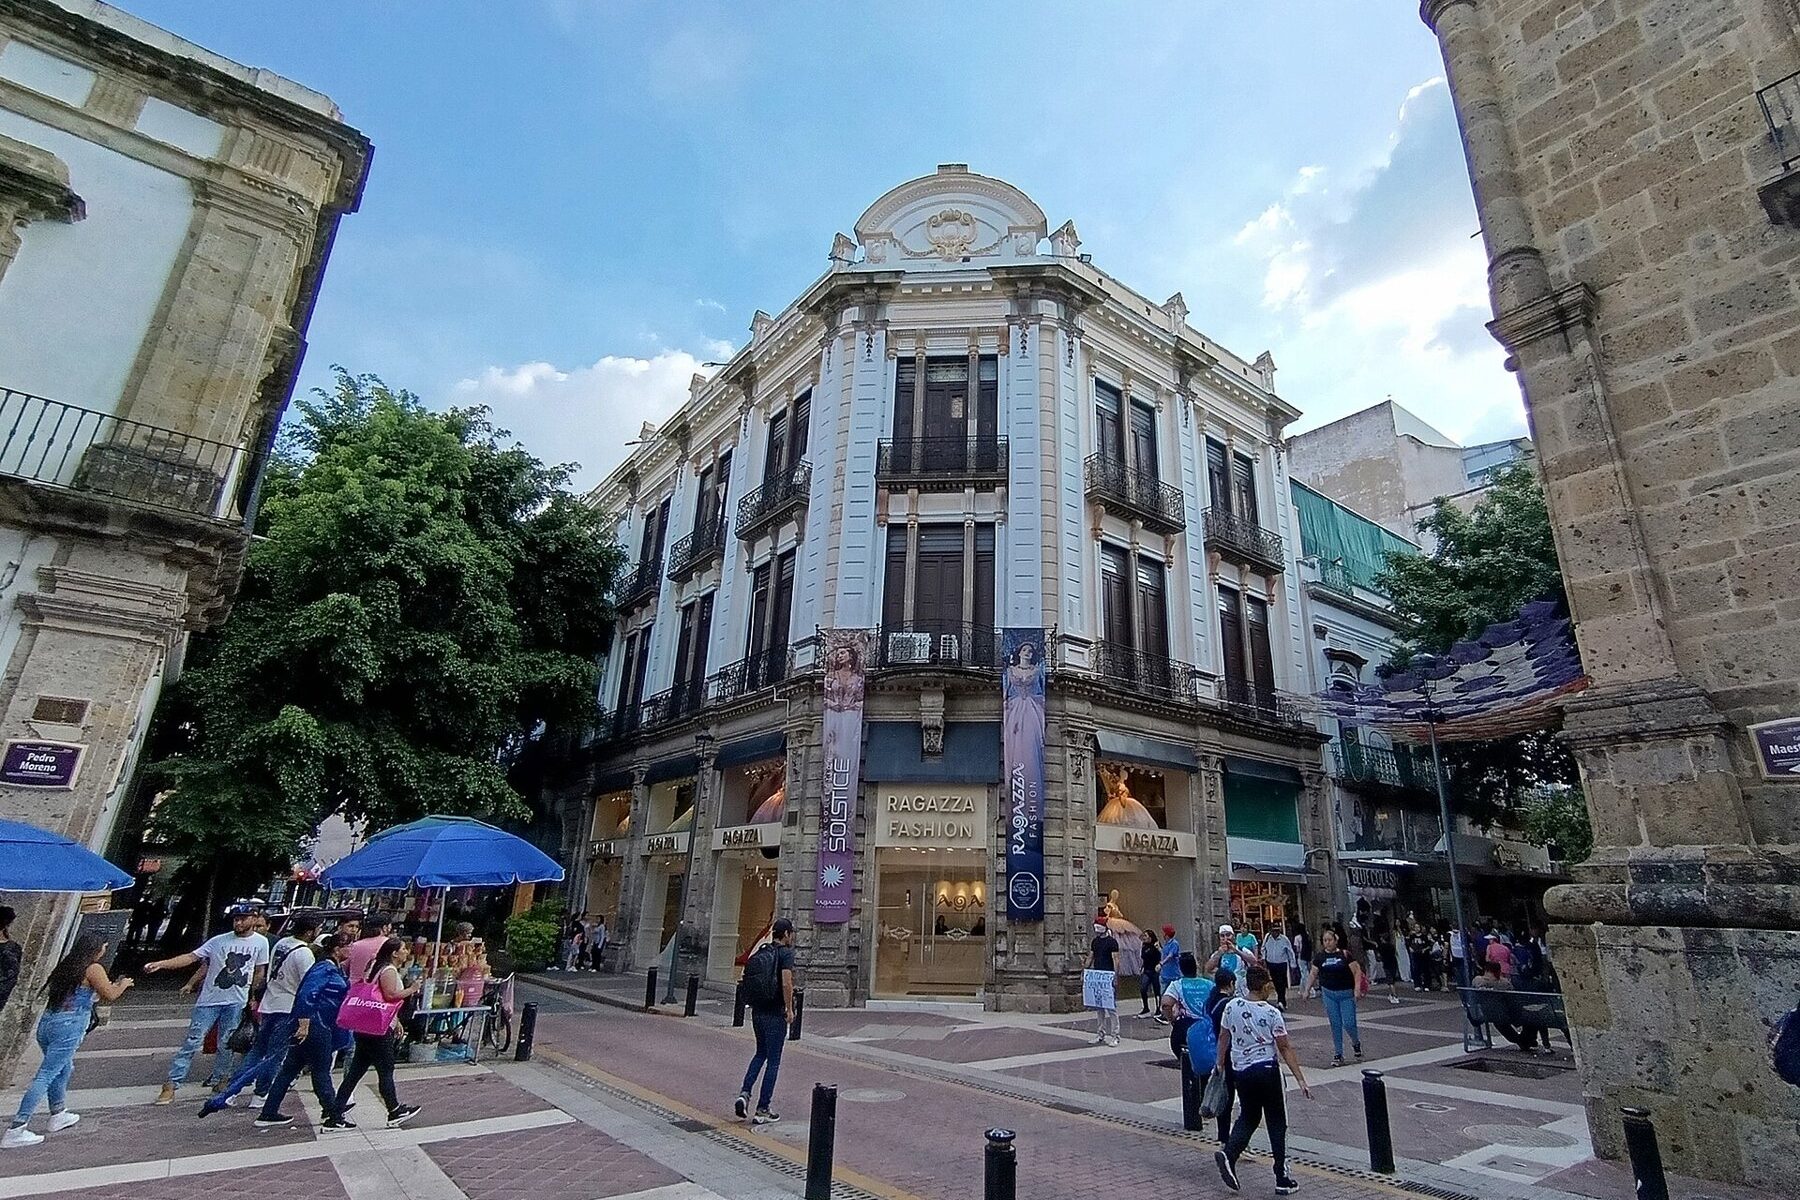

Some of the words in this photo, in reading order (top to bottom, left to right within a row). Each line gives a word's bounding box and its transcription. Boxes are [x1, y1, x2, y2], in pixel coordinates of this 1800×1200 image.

[19, 761, 57, 772] Moreno
[27, 753, 56, 763] Pedro
[829, 758, 850, 852] SOLSTICE
[887, 795, 975, 813] RAGAZZA
[1029, 781, 1037, 838] FASHION
[722, 828, 761, 846] RAGAZZA
[889, 820, 972, 837] FASHION
[1122, 832, 1179, 852] RAGAZZA
